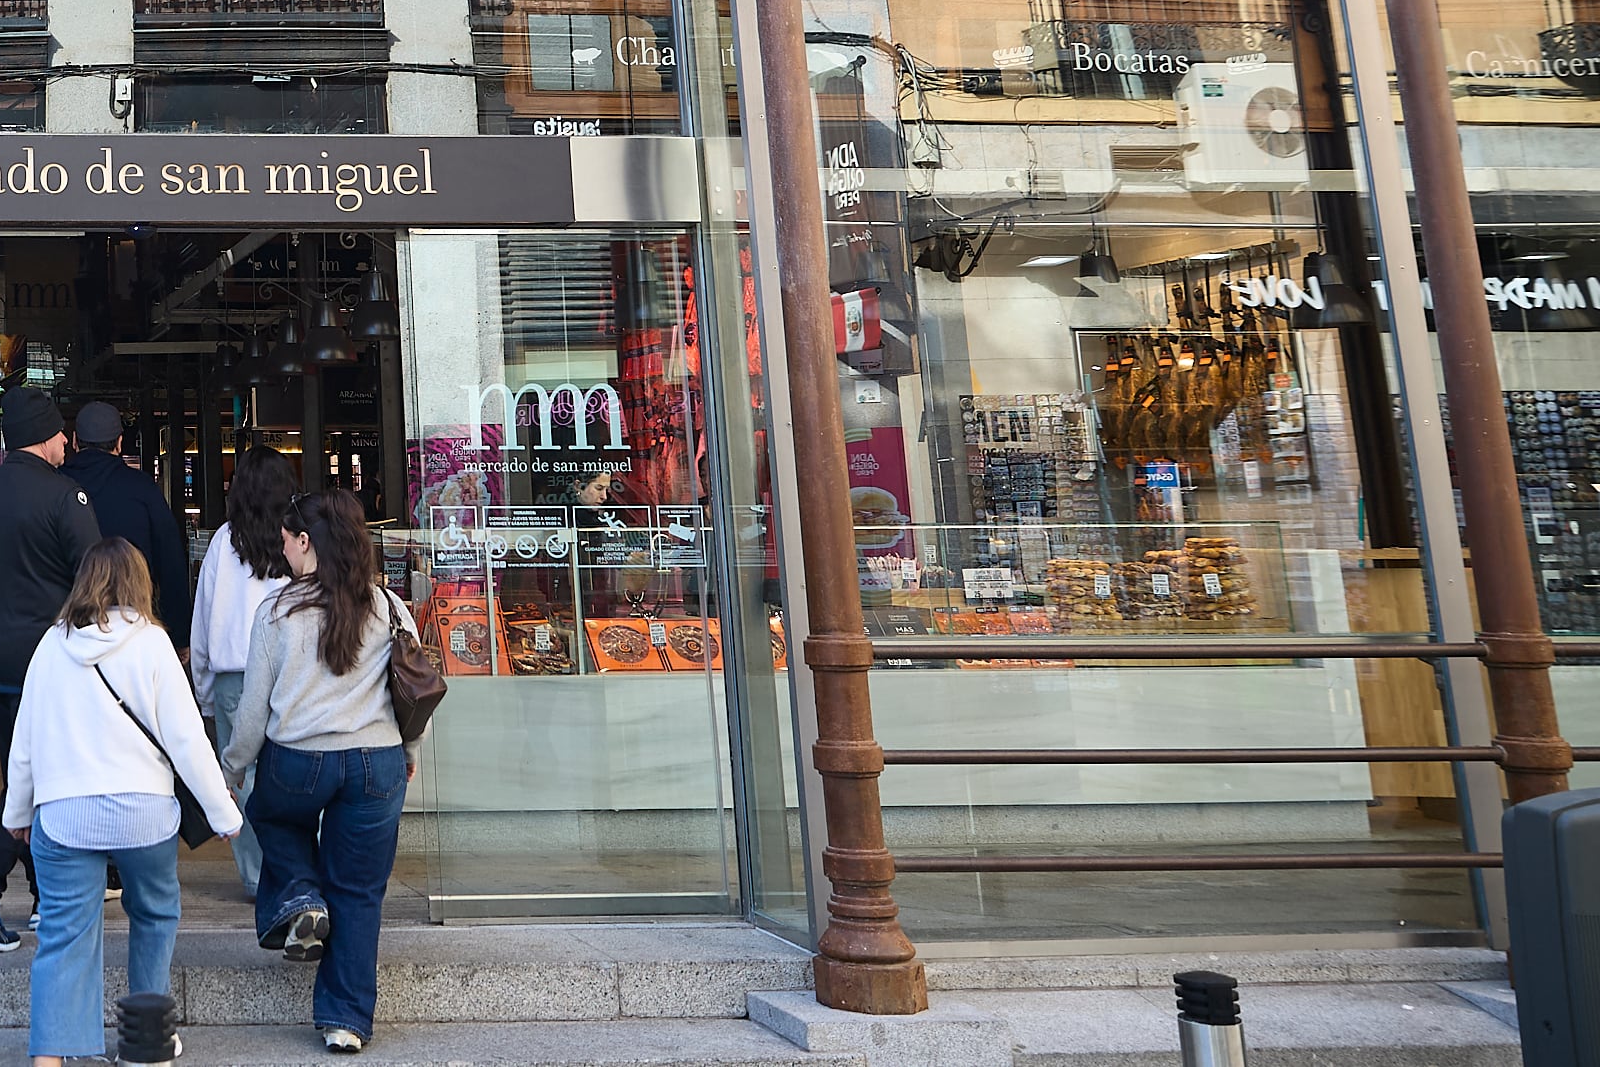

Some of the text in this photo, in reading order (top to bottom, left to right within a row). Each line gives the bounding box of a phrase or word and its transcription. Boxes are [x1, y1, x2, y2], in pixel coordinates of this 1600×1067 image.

[1070, 42, 1191, 74] Bocatas
[84, 147, 145, 195] de
[160, 160, 250, 195] san
[264, 147, 438, 213] miguel
[463, 457, 633, 477] mercado de san miguel
